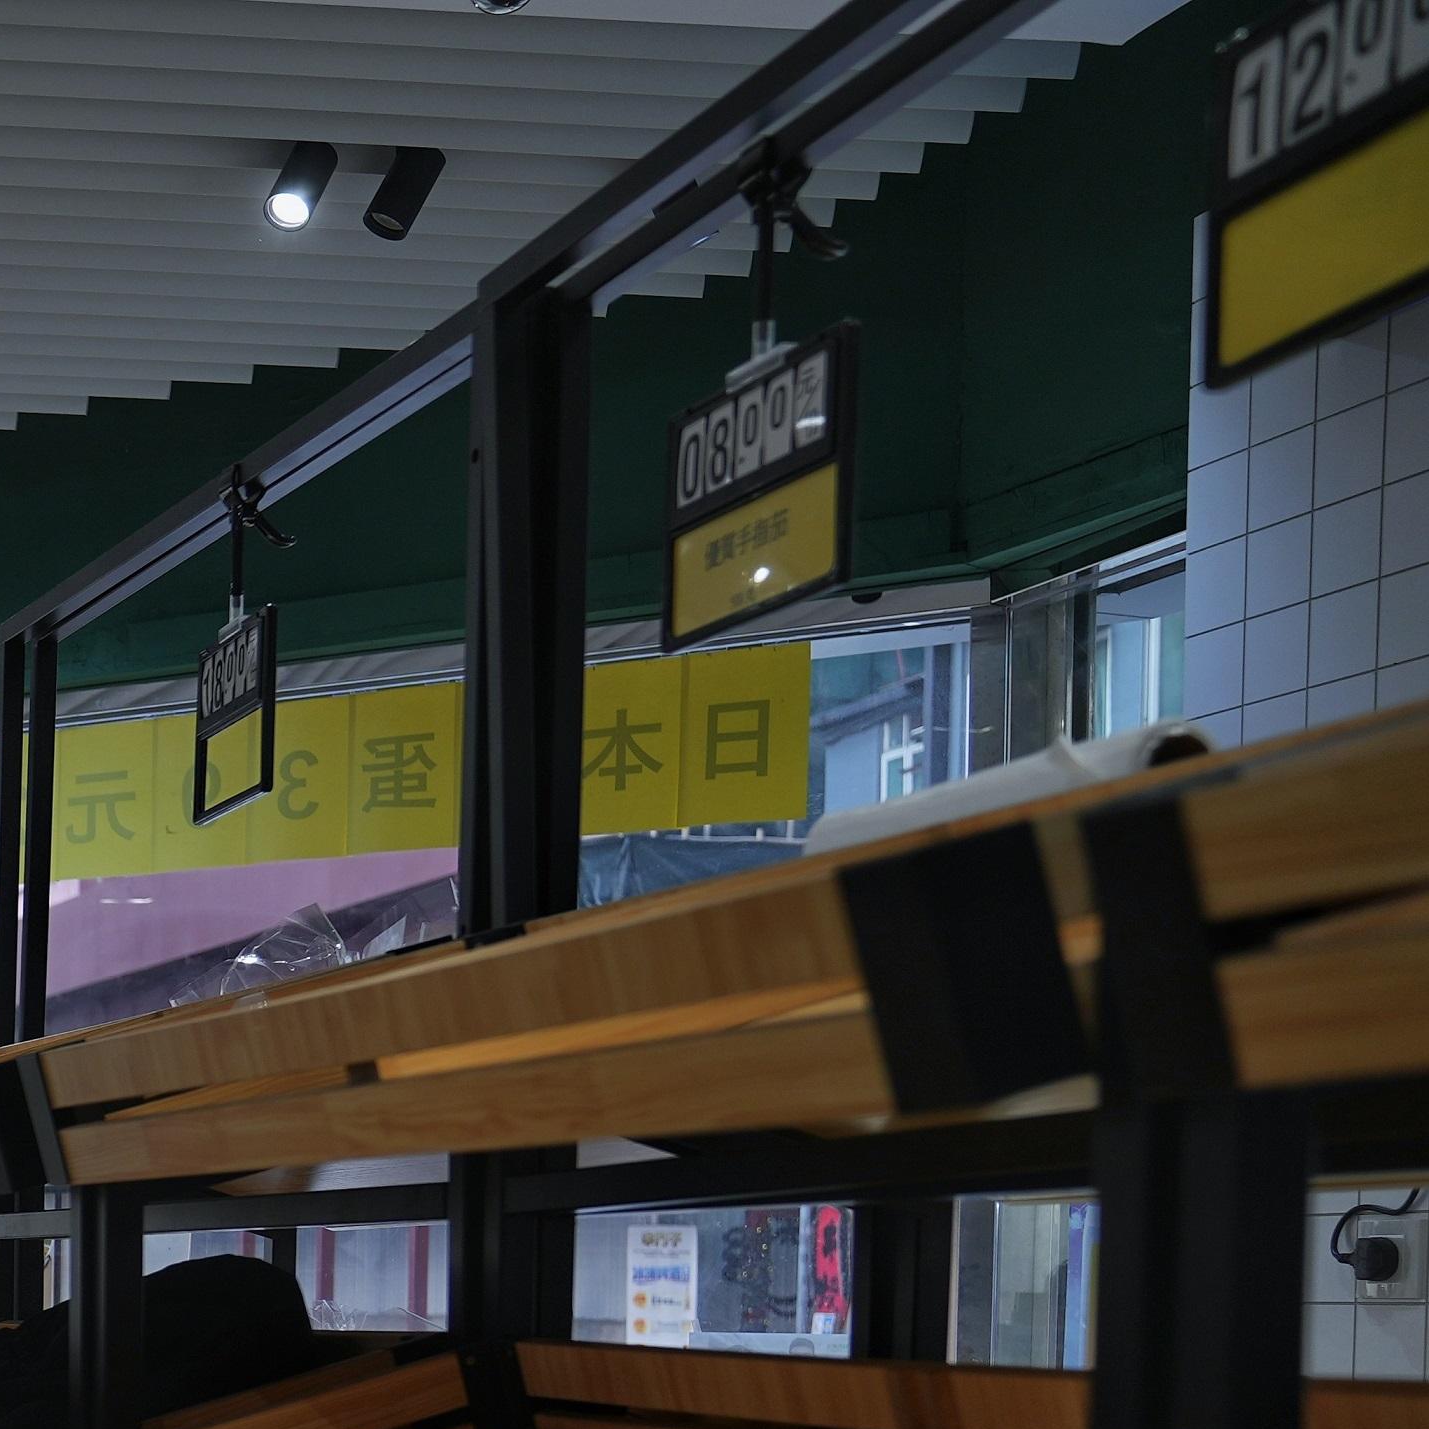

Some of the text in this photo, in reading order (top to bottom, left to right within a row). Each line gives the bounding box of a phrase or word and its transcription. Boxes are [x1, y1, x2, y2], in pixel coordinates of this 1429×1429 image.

[1243, 0, 1429, 155] 12.0
[683, 386, 786, 498] 08.00
[203, 644, 244, 711] 18.00
